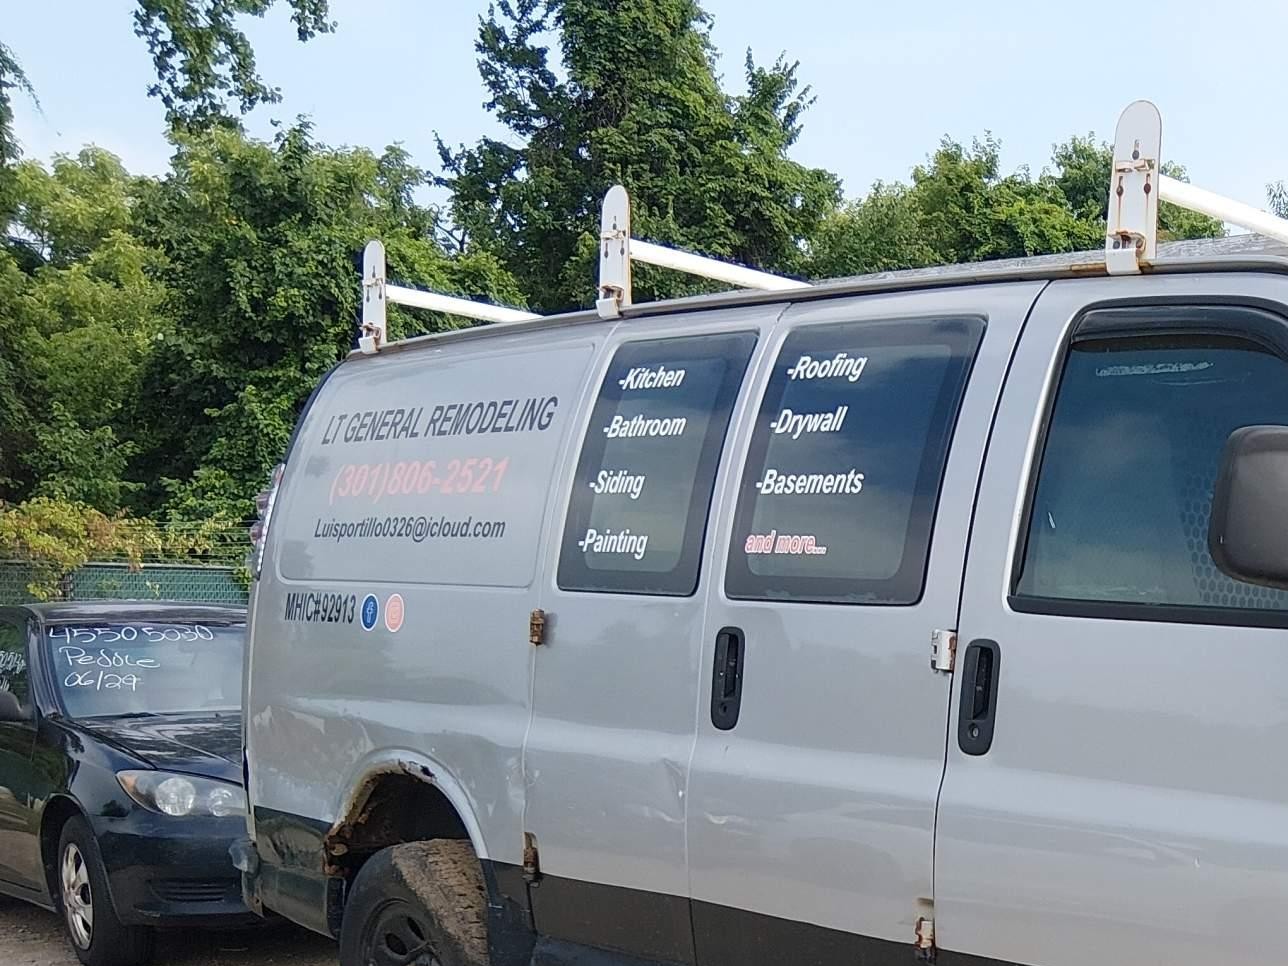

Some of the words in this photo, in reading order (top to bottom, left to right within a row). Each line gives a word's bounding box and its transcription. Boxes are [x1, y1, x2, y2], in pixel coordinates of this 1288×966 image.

[618, 367, 686, 391] -Kitchen
[786, 352, 868, 382] -Roofing
[321, 414, 347, 445] LT
[345, 408, 423, 442] GENERAL
[424, 396, 559, 436] REMODELING
[603, 415, 687, 439] -Bathroom
[770, 406, 849, 440] -Drywall
[329, 456, 510, 506] (301)806-2521
[589, 470, 646, 500] -Siding
[755, 468, 865, 495] -Basements
[314, 517, 506, 543] Luisportillo0326@icloud.com
[578, 528, 649, 560] -Painting
[744, 530, 774, 553] and
[774, 534, 828, 555] more...
[285, 593, 356, 624] MHIC#92913
[64, 670, 137, 692] 06/29
